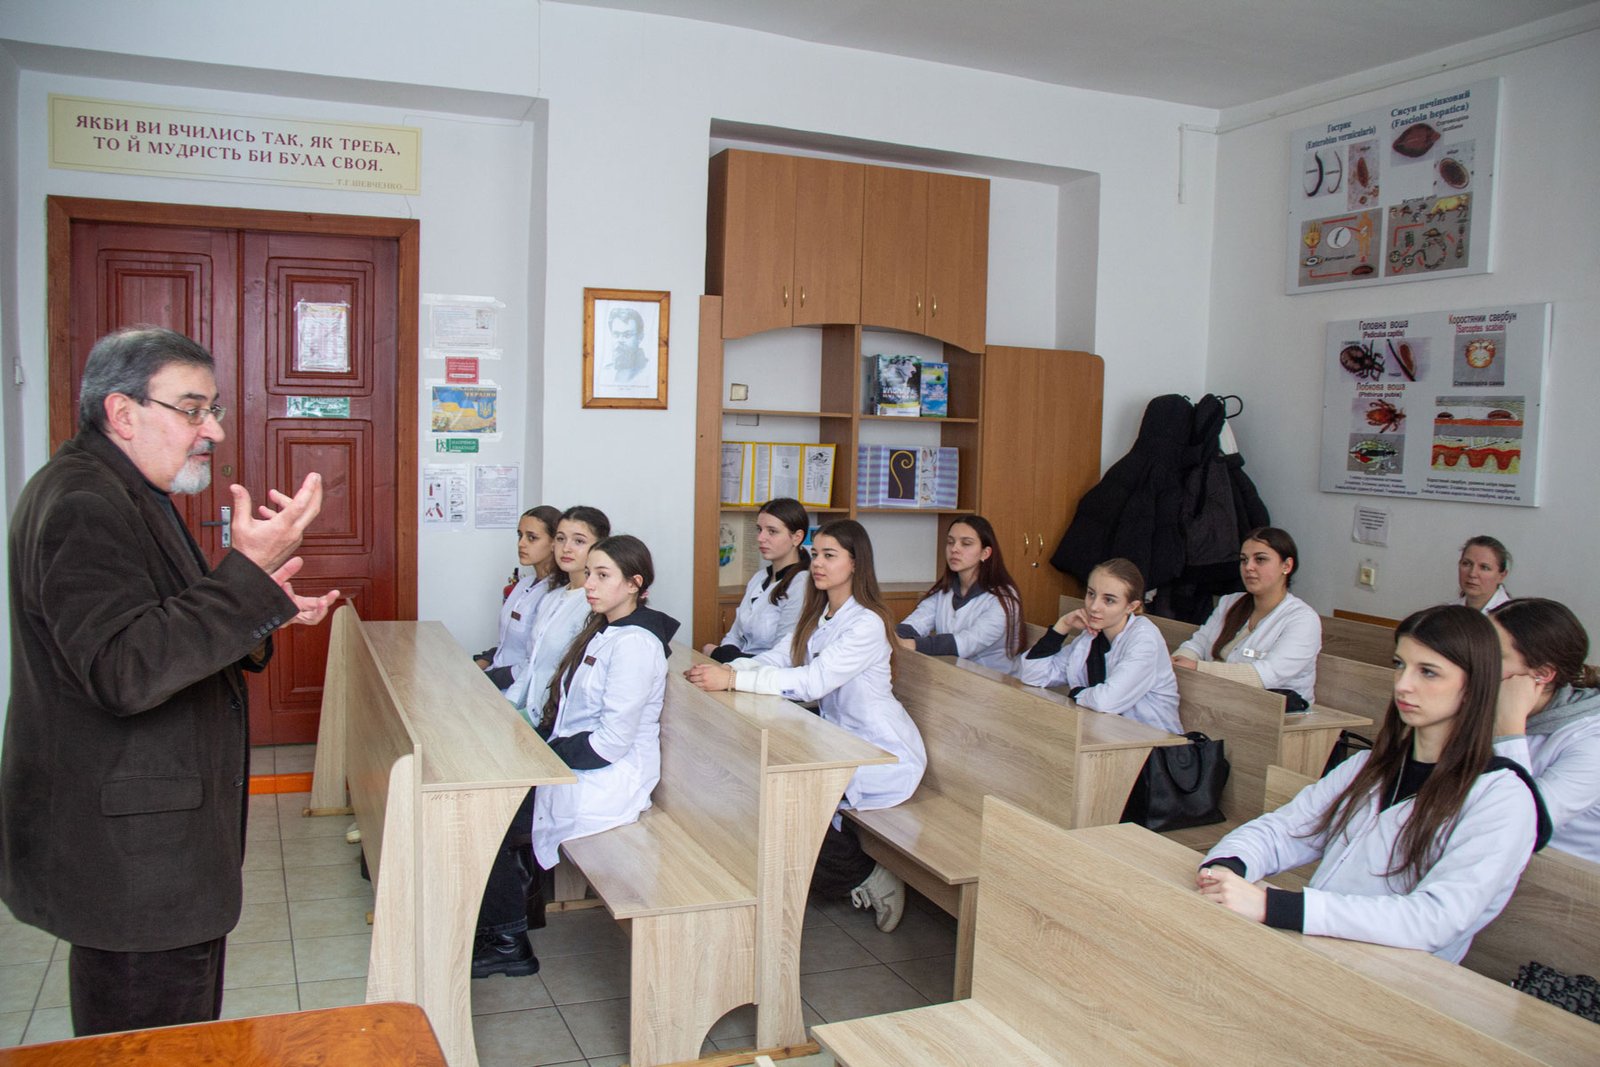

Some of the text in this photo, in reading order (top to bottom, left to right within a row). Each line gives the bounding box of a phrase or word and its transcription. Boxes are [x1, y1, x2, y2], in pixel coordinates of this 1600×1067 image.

[1391, 102, 1470, 129] (Fasciola hepatica)
[76, 115, 401, 156] ЯКБИ ВИ ВЧИЛИСЬ ТАК, ЯК ТРЕБА,
[93, 135, 383, 172] ТО Й МУДРІСТЬ БИ БУЛА СВОЯ.
[1359, 320, 1409, 331] Головна воша
[1387, 383, 1406, 391] воша
